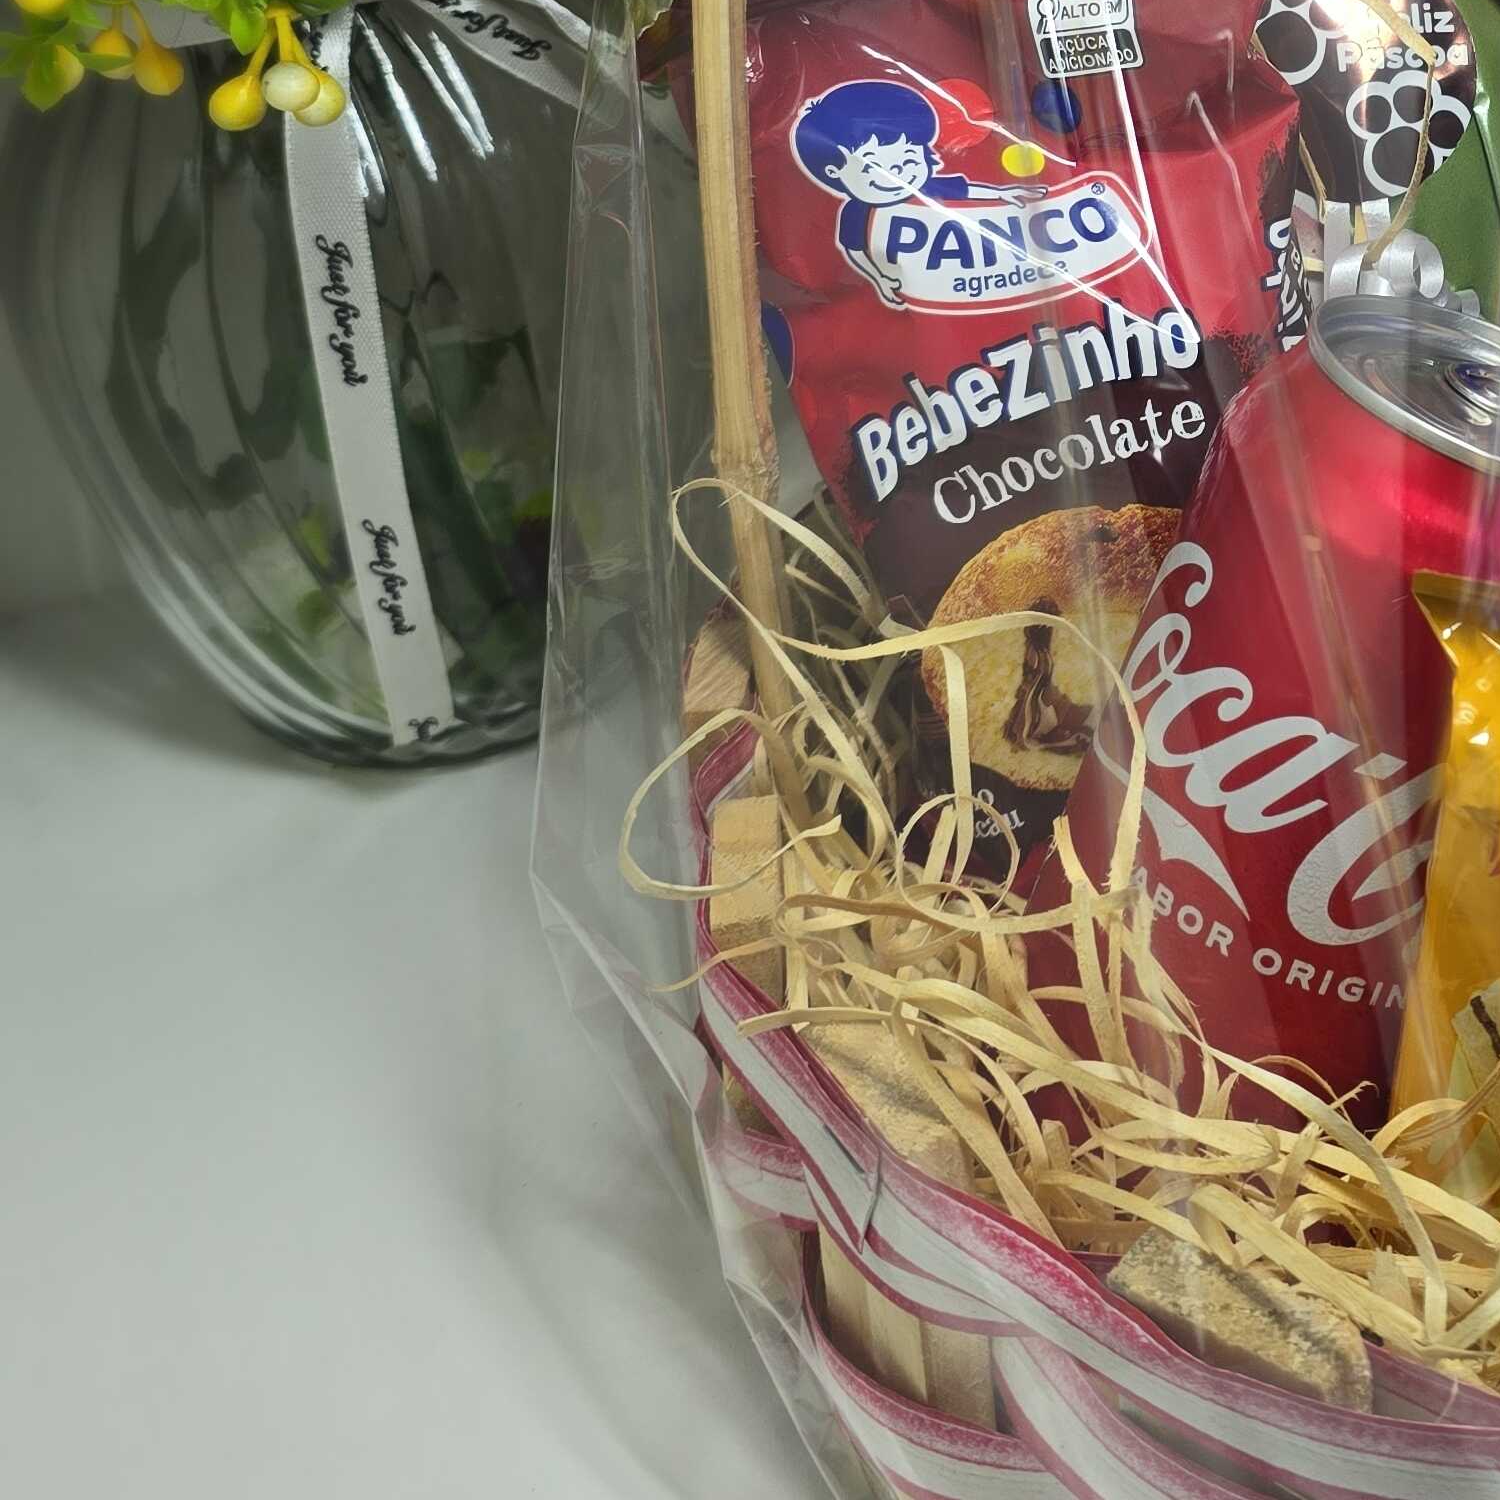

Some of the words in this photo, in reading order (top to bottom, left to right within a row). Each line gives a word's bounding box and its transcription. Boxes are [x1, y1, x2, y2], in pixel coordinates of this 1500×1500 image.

[1061, 2, 1101, 20] ALTO
[1049, 48, 1134, 72] ADICIONADO
[1058, 36, 1109, 56] AÇÚCA
[886, 197, 1119, 270] PANCO
[933, 398, 1206, 524] Chocolate
[1132, 866, 1235, 957] ABOR
[1252, 947, 1406, 1009] ORIGIN
